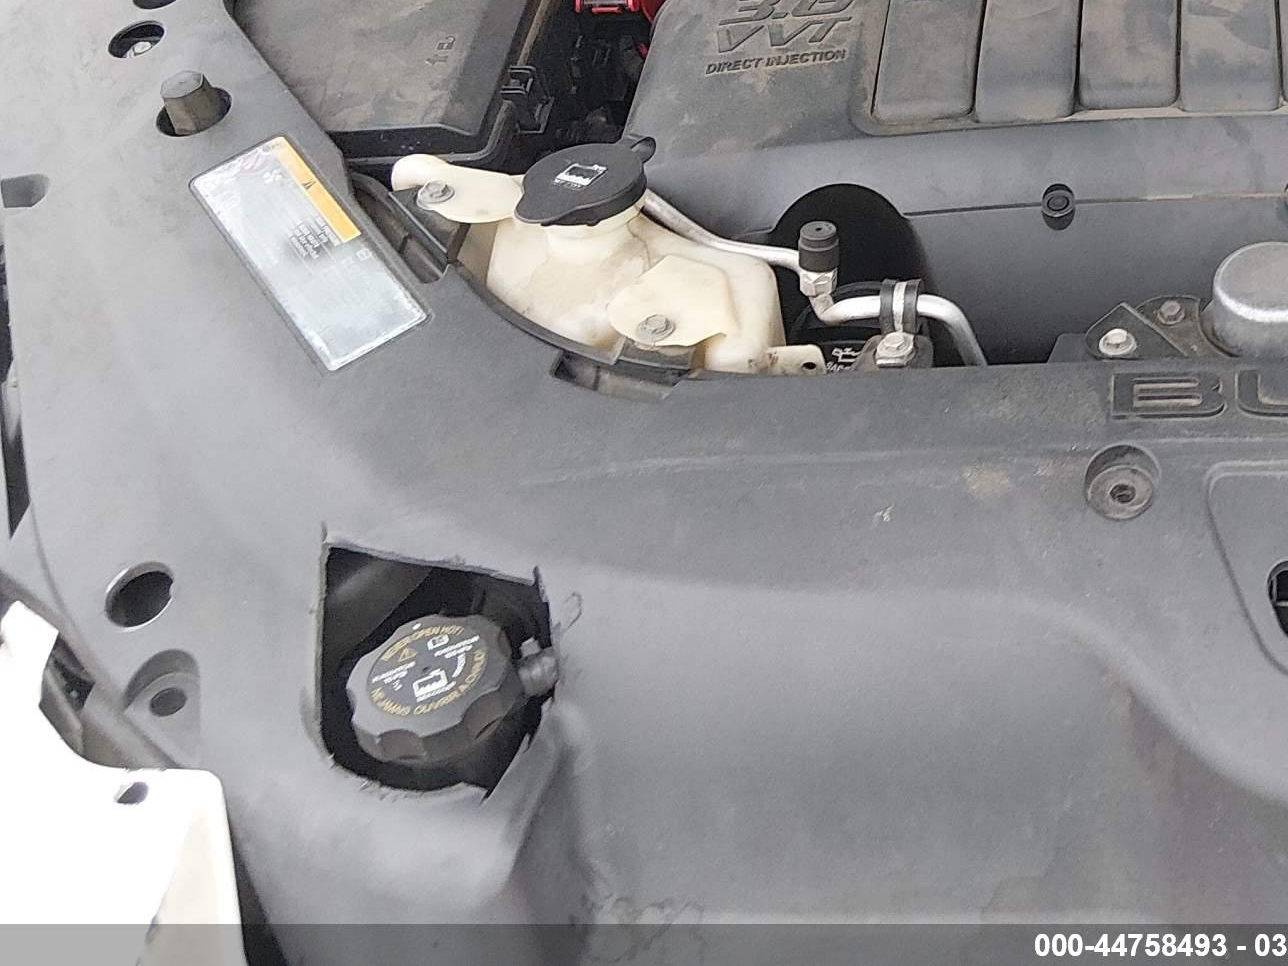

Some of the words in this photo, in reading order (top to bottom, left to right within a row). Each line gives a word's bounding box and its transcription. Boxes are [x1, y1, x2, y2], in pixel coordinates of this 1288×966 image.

[717, 16, 853, 54] VVT
[705, 57, 763, 75] DIRECT
[764, 48, 846, 68] INJECTION
